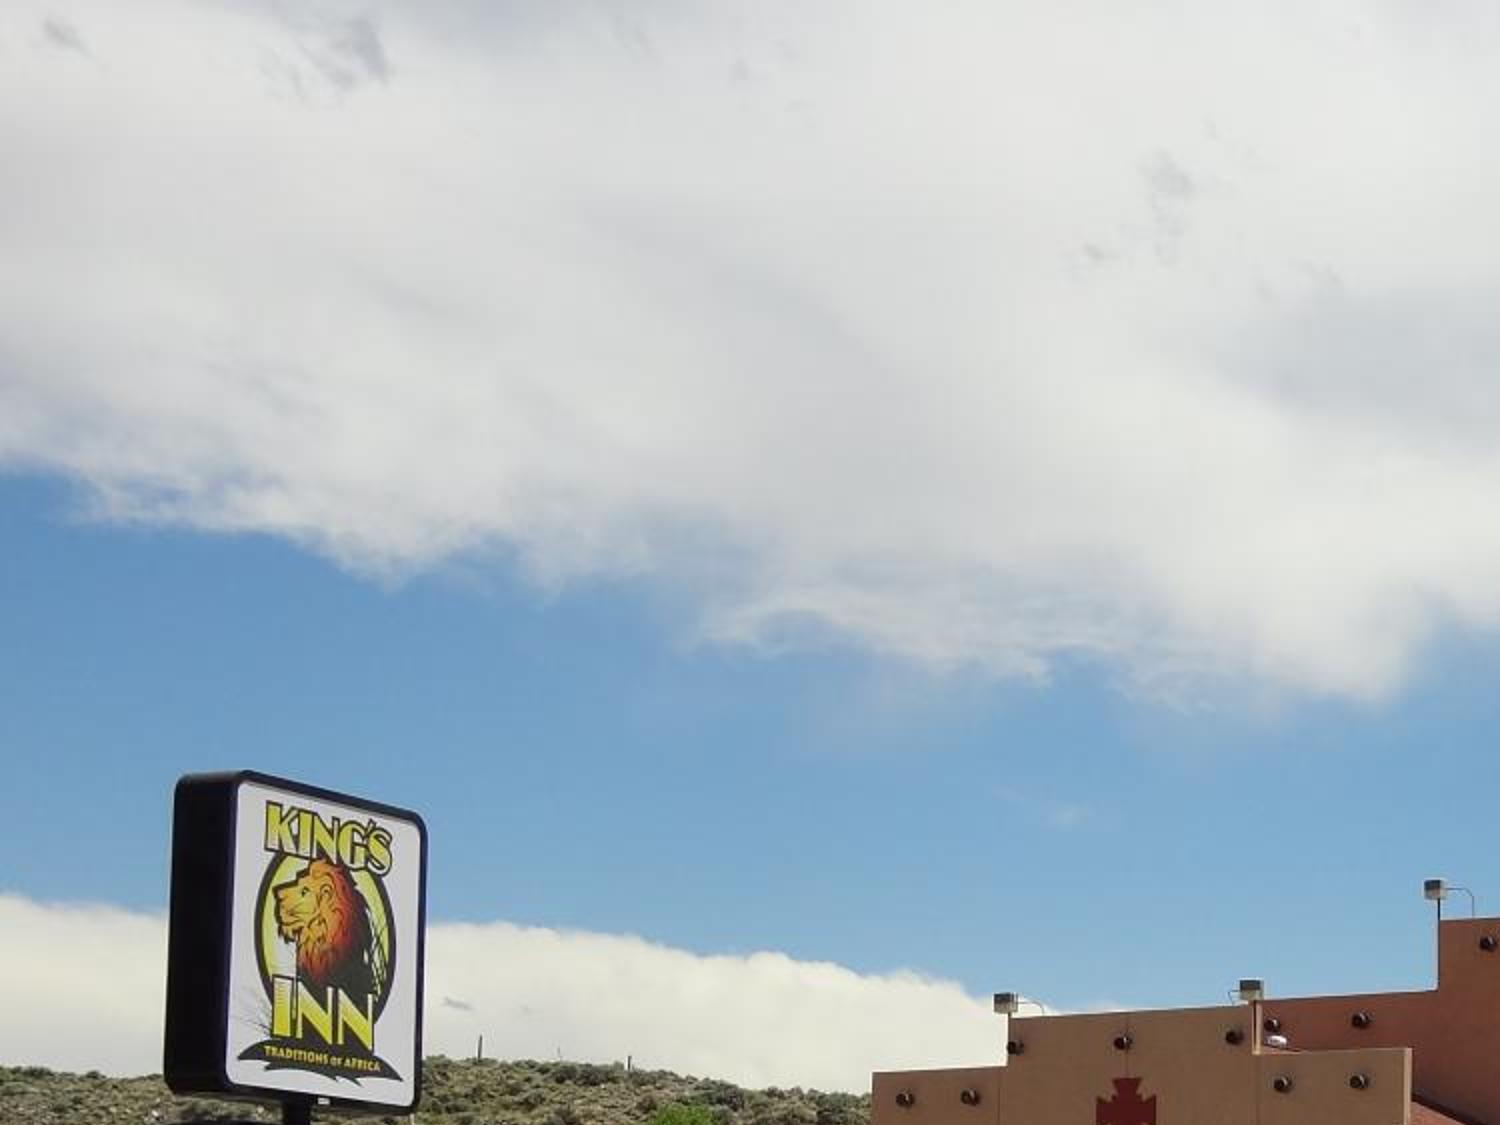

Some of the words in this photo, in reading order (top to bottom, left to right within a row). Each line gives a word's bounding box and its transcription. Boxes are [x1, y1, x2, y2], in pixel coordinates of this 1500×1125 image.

[264, 800, 393, 876] KING'S
[271, 974, 375, 1054] INN
[264, 1045, 329, 1064] TRADITIONS
[343, 1057, 381, 1072] AFRICA
